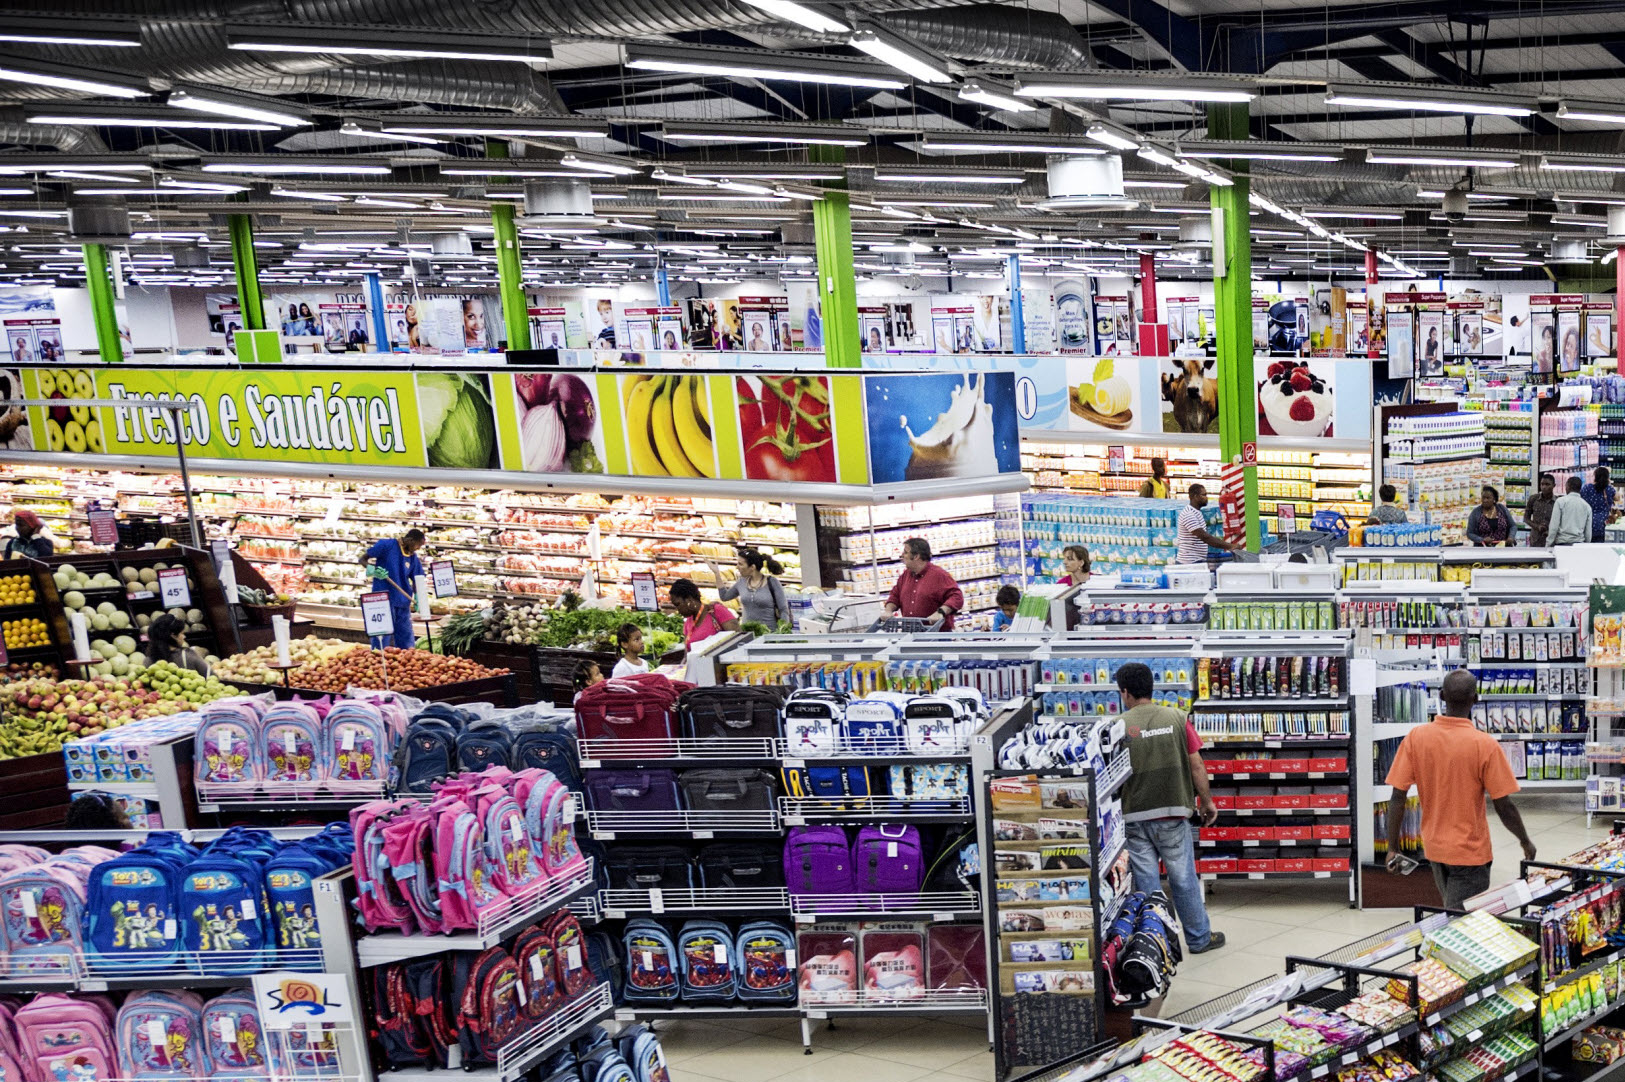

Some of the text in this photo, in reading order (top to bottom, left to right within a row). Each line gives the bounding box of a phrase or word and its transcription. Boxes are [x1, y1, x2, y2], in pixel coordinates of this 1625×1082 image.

[108, 381, 407, 454] Fresco e Saudável
[318, 882, 332, 892] F1
